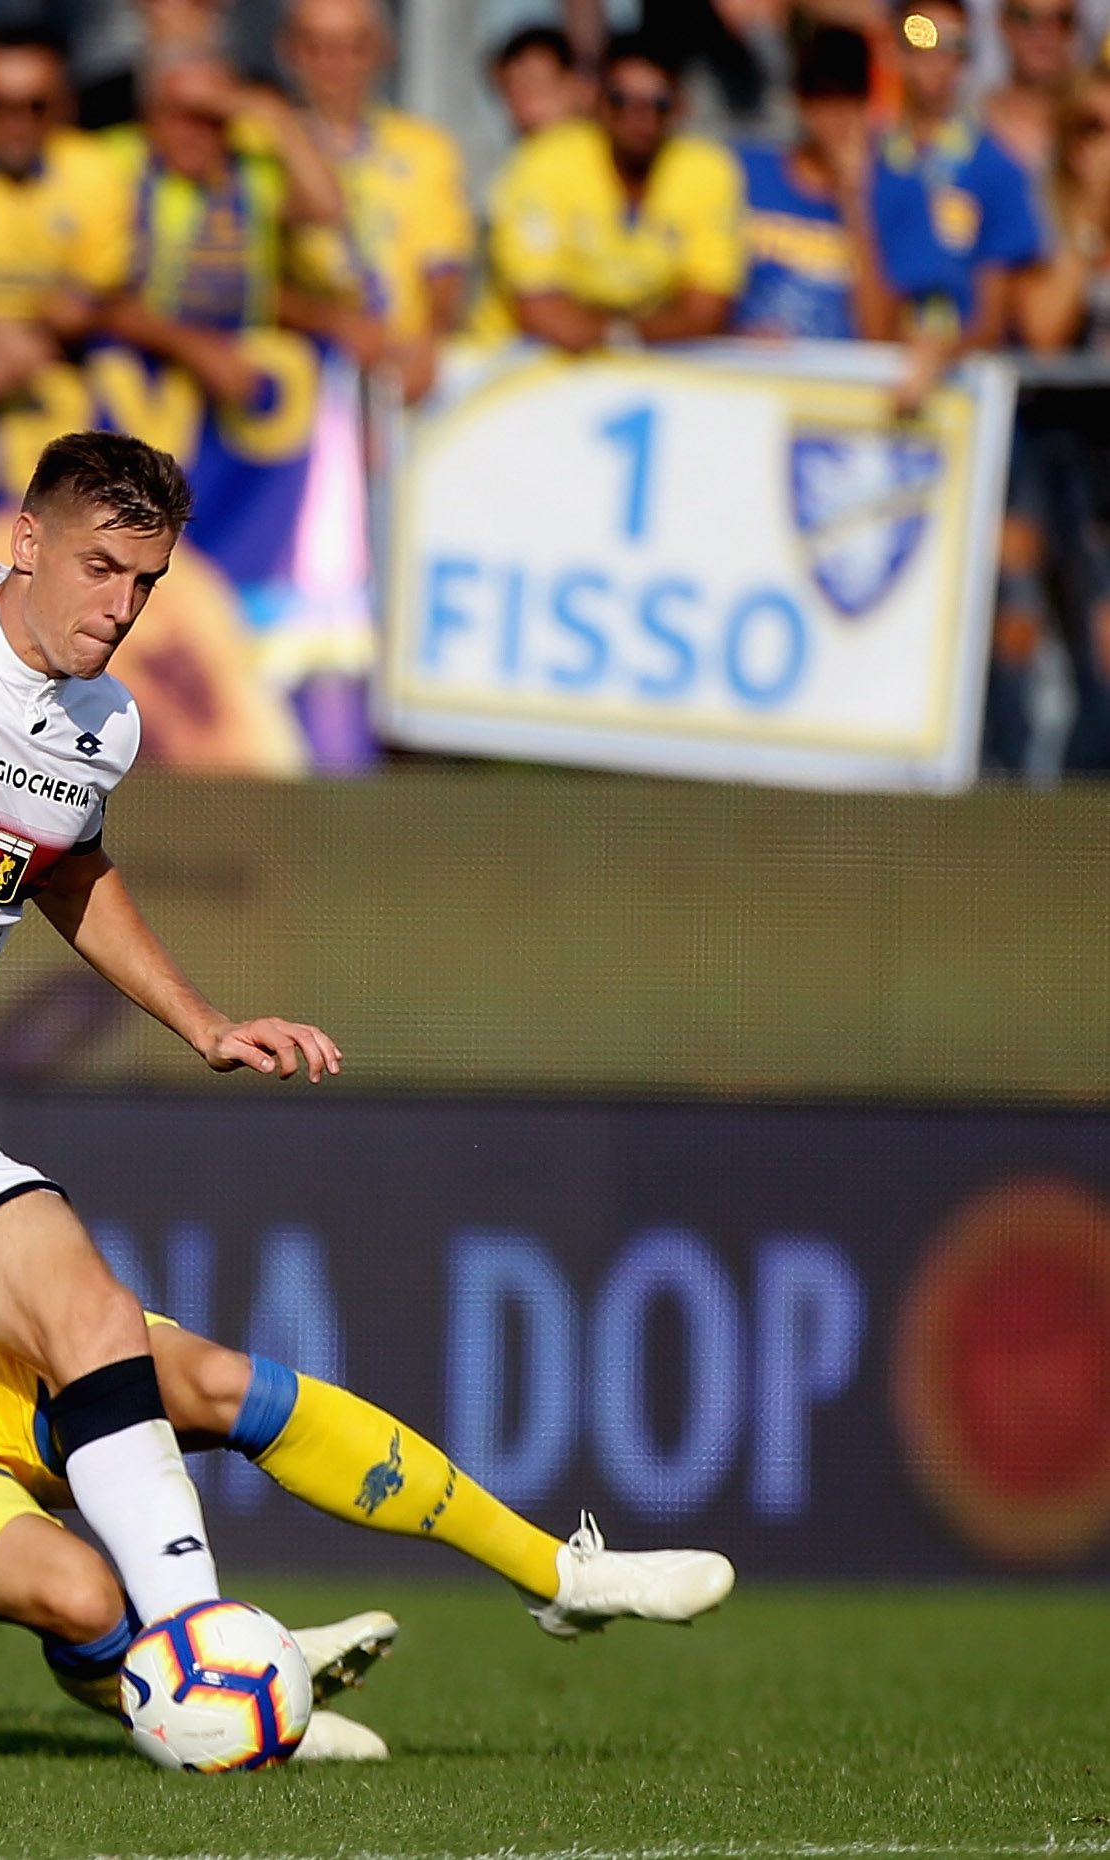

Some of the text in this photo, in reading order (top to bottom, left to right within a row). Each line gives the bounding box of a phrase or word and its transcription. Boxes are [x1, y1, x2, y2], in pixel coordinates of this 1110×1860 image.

[599, 400, 658, 545] 1
[420, 558, 810, 712] FISSO
[443, 1222, 866, 1518] DOP
